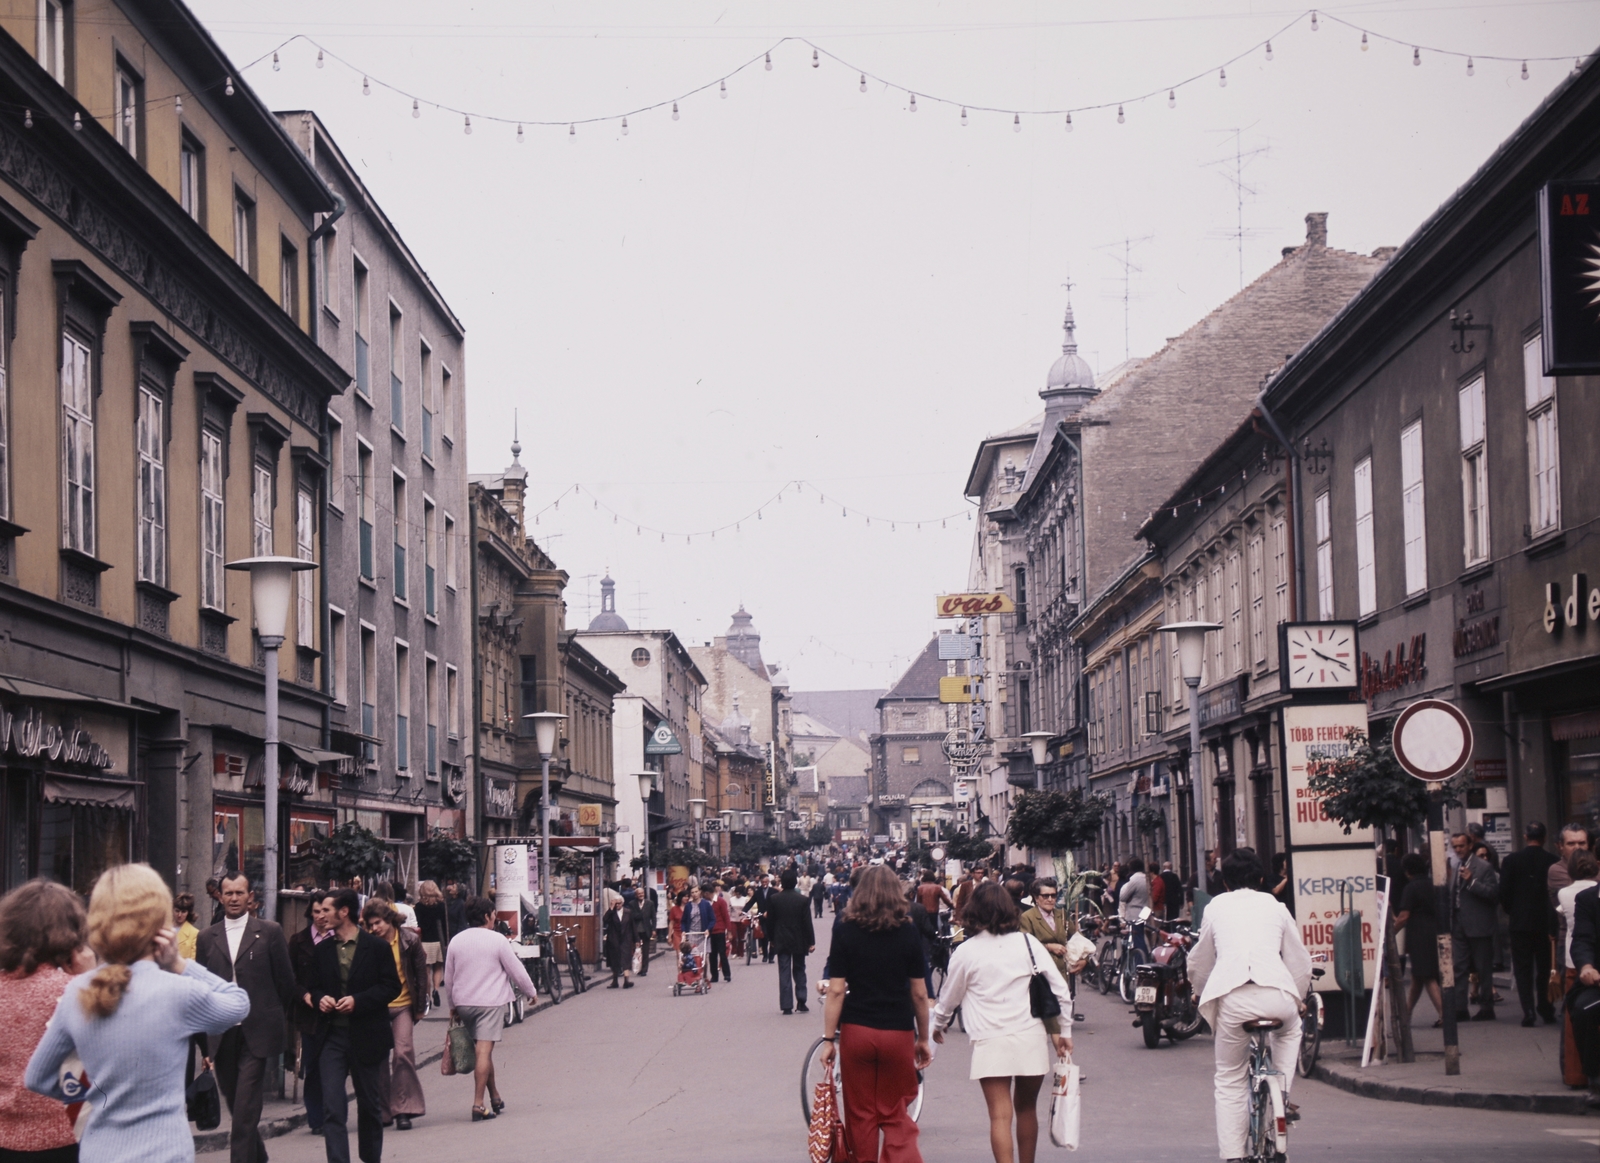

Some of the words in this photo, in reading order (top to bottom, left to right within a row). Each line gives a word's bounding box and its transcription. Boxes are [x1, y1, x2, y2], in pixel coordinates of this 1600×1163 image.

[1560, 193, 1590, 215] AZ
[942, 595, 1003, 614] vas
[1290, 726, 1314, 742] TÖBB
[1298, 876, 1374, 895] KERESSE
[1309, 912, 1318, 920] A
[1303, 921, 1373, 946] HÚSR
